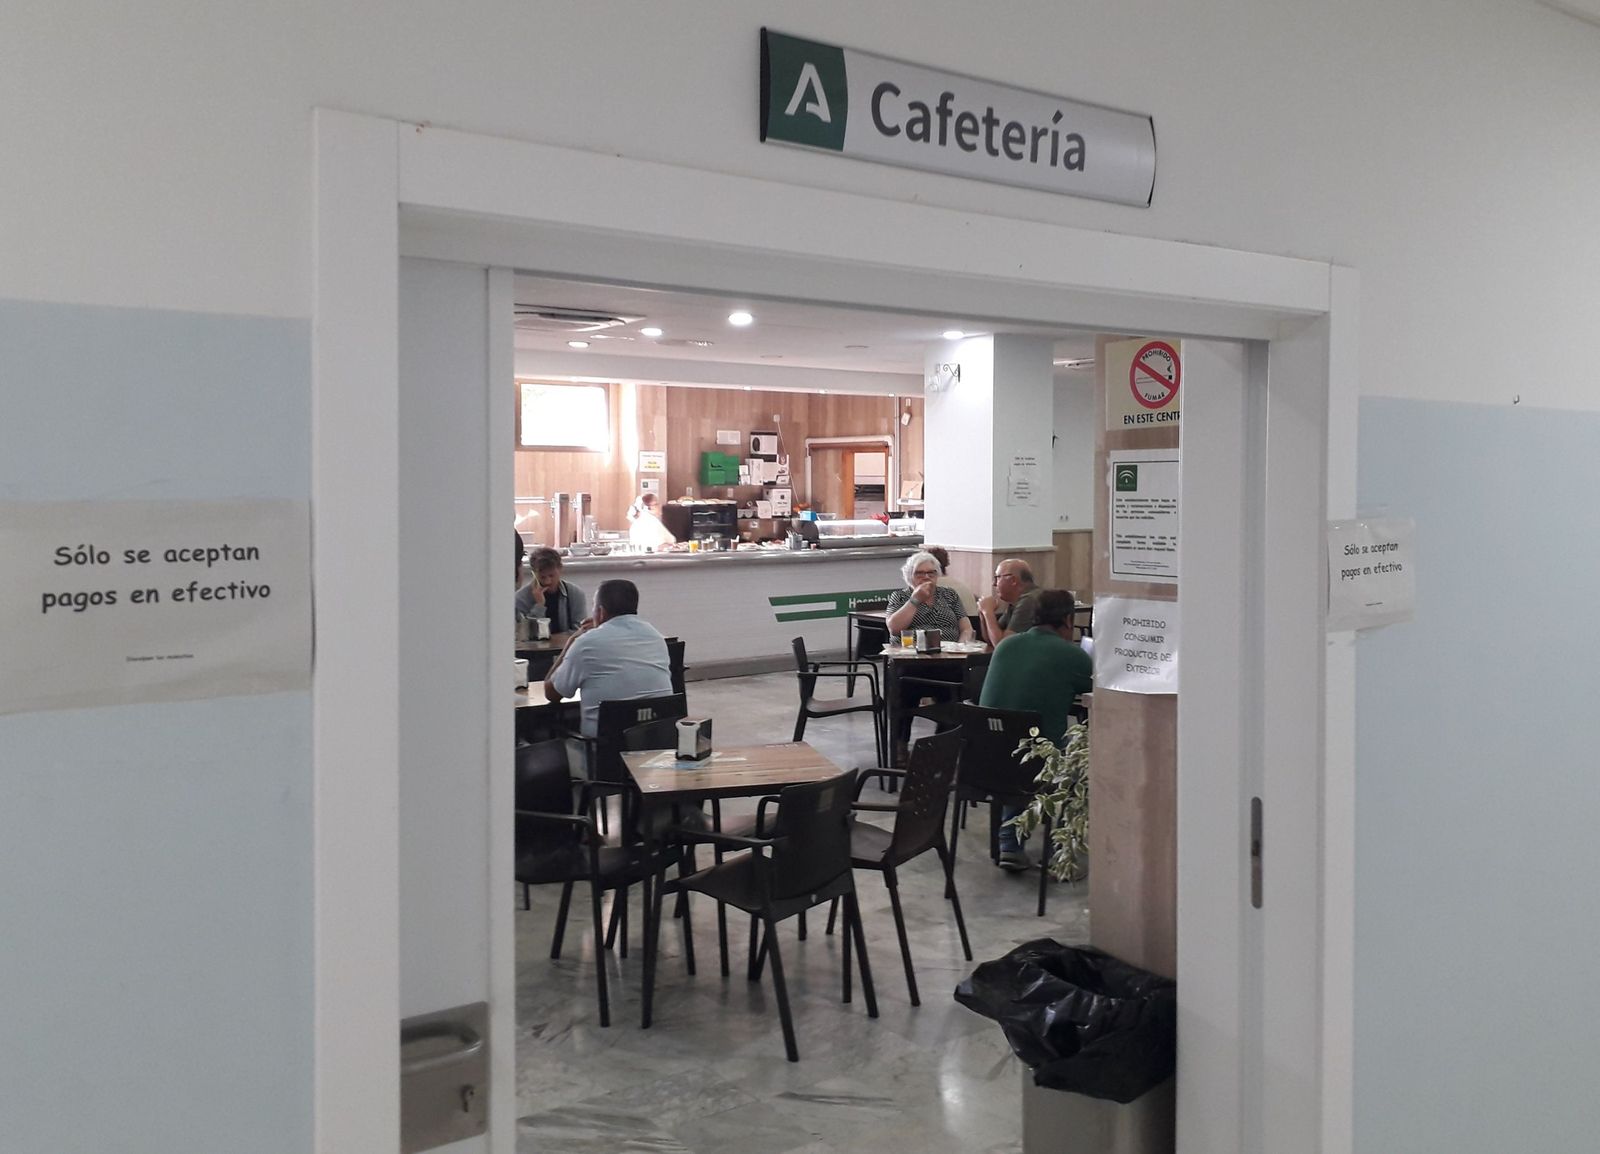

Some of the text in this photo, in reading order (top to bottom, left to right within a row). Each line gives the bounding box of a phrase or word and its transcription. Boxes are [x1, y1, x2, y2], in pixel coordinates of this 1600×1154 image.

[870, 81, 1086, 172] Cafetería
[1144, 391, 1165, 400] FUMAR
[1123, 414, 1135, 425] EN
[1136, 413, 1154, 424] ESTE
[54, 544, 260, 568] Sólo se aceptan
[1344, 543, 1398, 556] Sólo se aceptan
[1341, 562, 1402, 580] pagos en efectivo
[41, 580, 271, 614] pagos en efectivo
[1122, 617, 1166, 629] PROHIBIDO
[1124, 632, 1164, 644] CONSUMIR
[1114, 647, 1158, 661] PRODUCTOS
